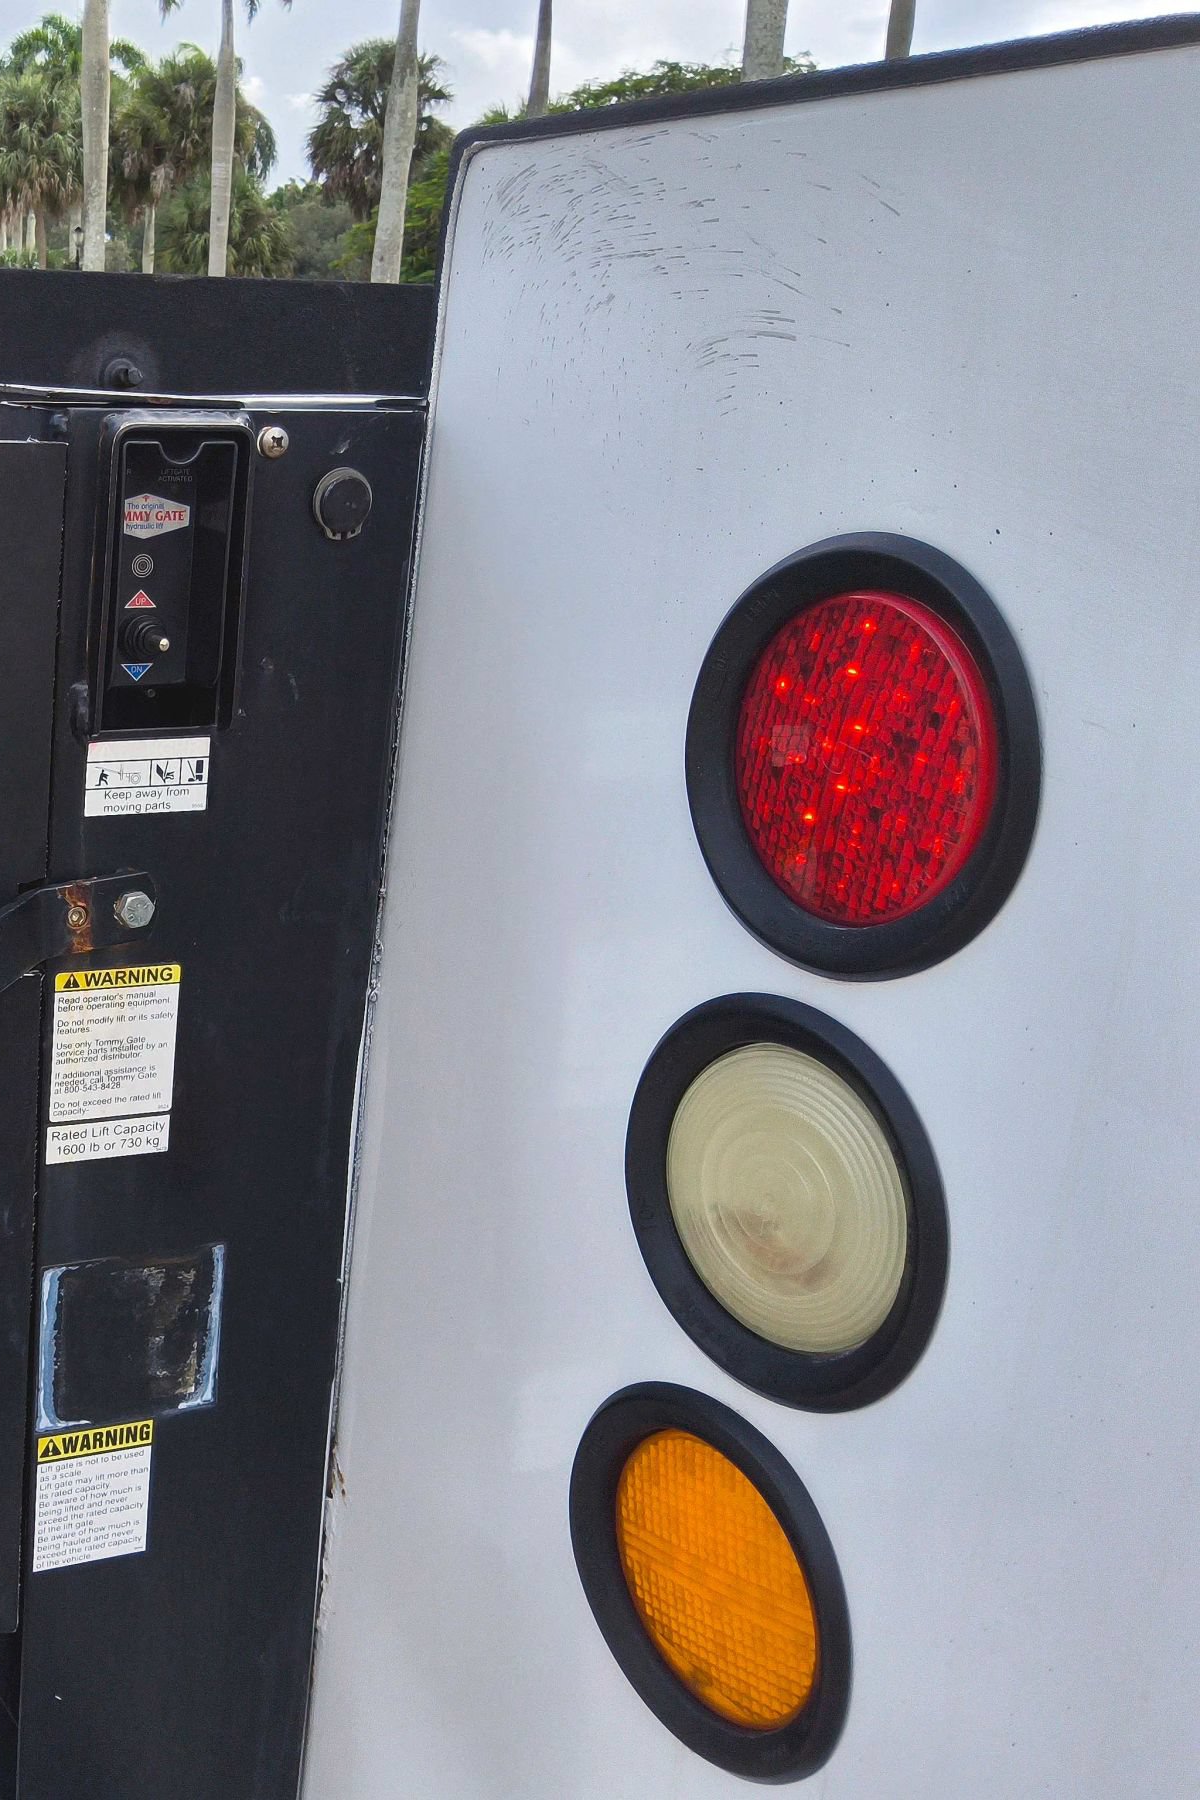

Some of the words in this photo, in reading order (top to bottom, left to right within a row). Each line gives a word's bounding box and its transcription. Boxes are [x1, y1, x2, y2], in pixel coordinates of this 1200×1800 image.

[142, 503, 164, 512] original
[156, 511, 184, 521] GATE
[126, 523, 154, 531] hydraulic
[104, 791, 131, 800] Keep
[136, 790, 162, 799] away
[167, 787, 189, 796] from
[104, 803, 141, 813] moving
[145, 802, 171, 811] parts
[85, 967, 173, 987] WARNING
[83, 993, 123, 1003] operator's
[127, 991, 156, 999] manual
[58, 1004, 83, 1012] before
[87, 1001, 124, 1010] operating
[87, 1017, 114, 1025] modify
[56, 1049, 84, 1057] service
[88, 1048, 107, 1056] parts
[110, 1044, 143, 1052] installed
[75, 1041, 92, 1049] only
[96, 1039, 123, 1047] Tommy
[56, 1056, 98, 1065] authorized
[63, 1070, 101, 1079] additional
[105, 1066, 146, 1075] assistance
[107, 1074, 134, 1083] Tommy
[83, 1098, 111, 1106] exceed
[52, 1129, 87, 1141] Rated
[92, 1126, 109, 1137] Lift
[114, 1122, 165, 1135] Capacity
[57, 1144, 85, 1155] 1600
[90, 1143, 100, 1152] lb
[104, 1142, 116, 1150] or
[121, 1138, 142, 1148] 730
[146, 1137, 159, 1147] kg
[62, 1424, 150, 1454] WARNING
[56, 1463, 73, 1471] gate
[124, 1450, 144, 1459] used
[40, 1483, 51, 1491] Lift
[55, 1481, 72, 1489] gate
[76, 1477, 92, 1486] may
[108, 1471, 128, 1479] more
[131, 1467, 148, 1475] than
[51, 1489, 72, 1498] rated
[91, 1491, 107, 1499] how
[110, 1486, 133, 1495] much
[38, 1516, 68, 1526] exceed
[86, 1509, 107, 1517] rated
[110, 1502, 144, 1513] capacity
[39, 1509, 62, 1517] being
[51, 1532, 76, 1540] aware
[79, 1528, 86, 1536] of
[108, 1522, 131, 1530] much
[37, 1544, 60, 1552] being
[63, 1536, 91, 1546] hauled
[112, 1529, 134, 1537] never
[37, 1551, 67, 1561] exceed
[85, 1543, 105, 1551] rated
[108, 1536, 142, 1547] capacity
